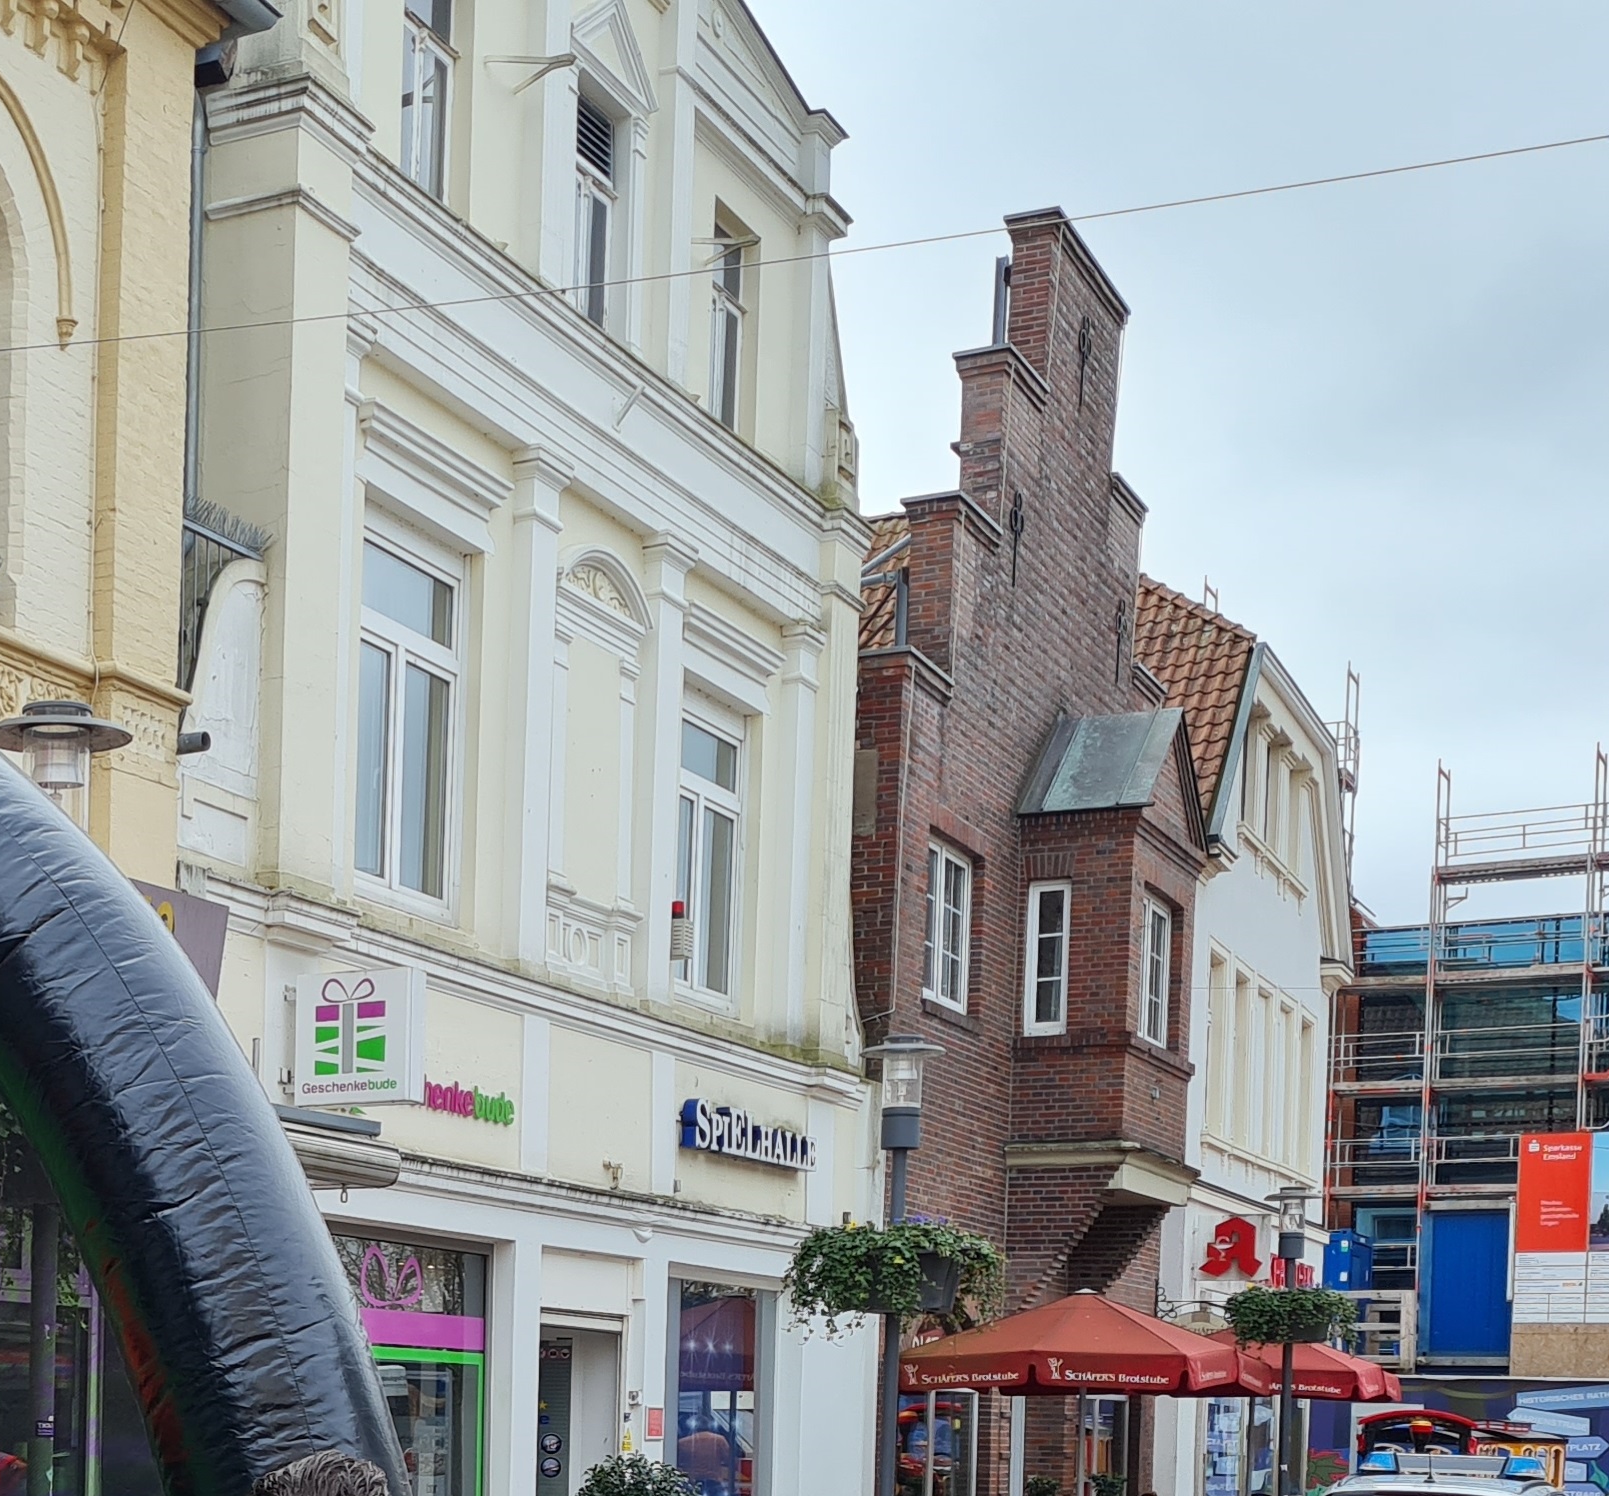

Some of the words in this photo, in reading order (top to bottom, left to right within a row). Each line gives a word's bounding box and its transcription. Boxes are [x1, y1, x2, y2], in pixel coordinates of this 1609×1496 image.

[302, 1078, 397, 1095] Geschenkebude
[694, 1097, 818, 1172] SPIELHALLE
[972, 1371, 1020, 1381] Brotstube
[1118, 1373, 1170, 1385] Brotstube
[1298, 1383, 1342, 1394] Brotstube
